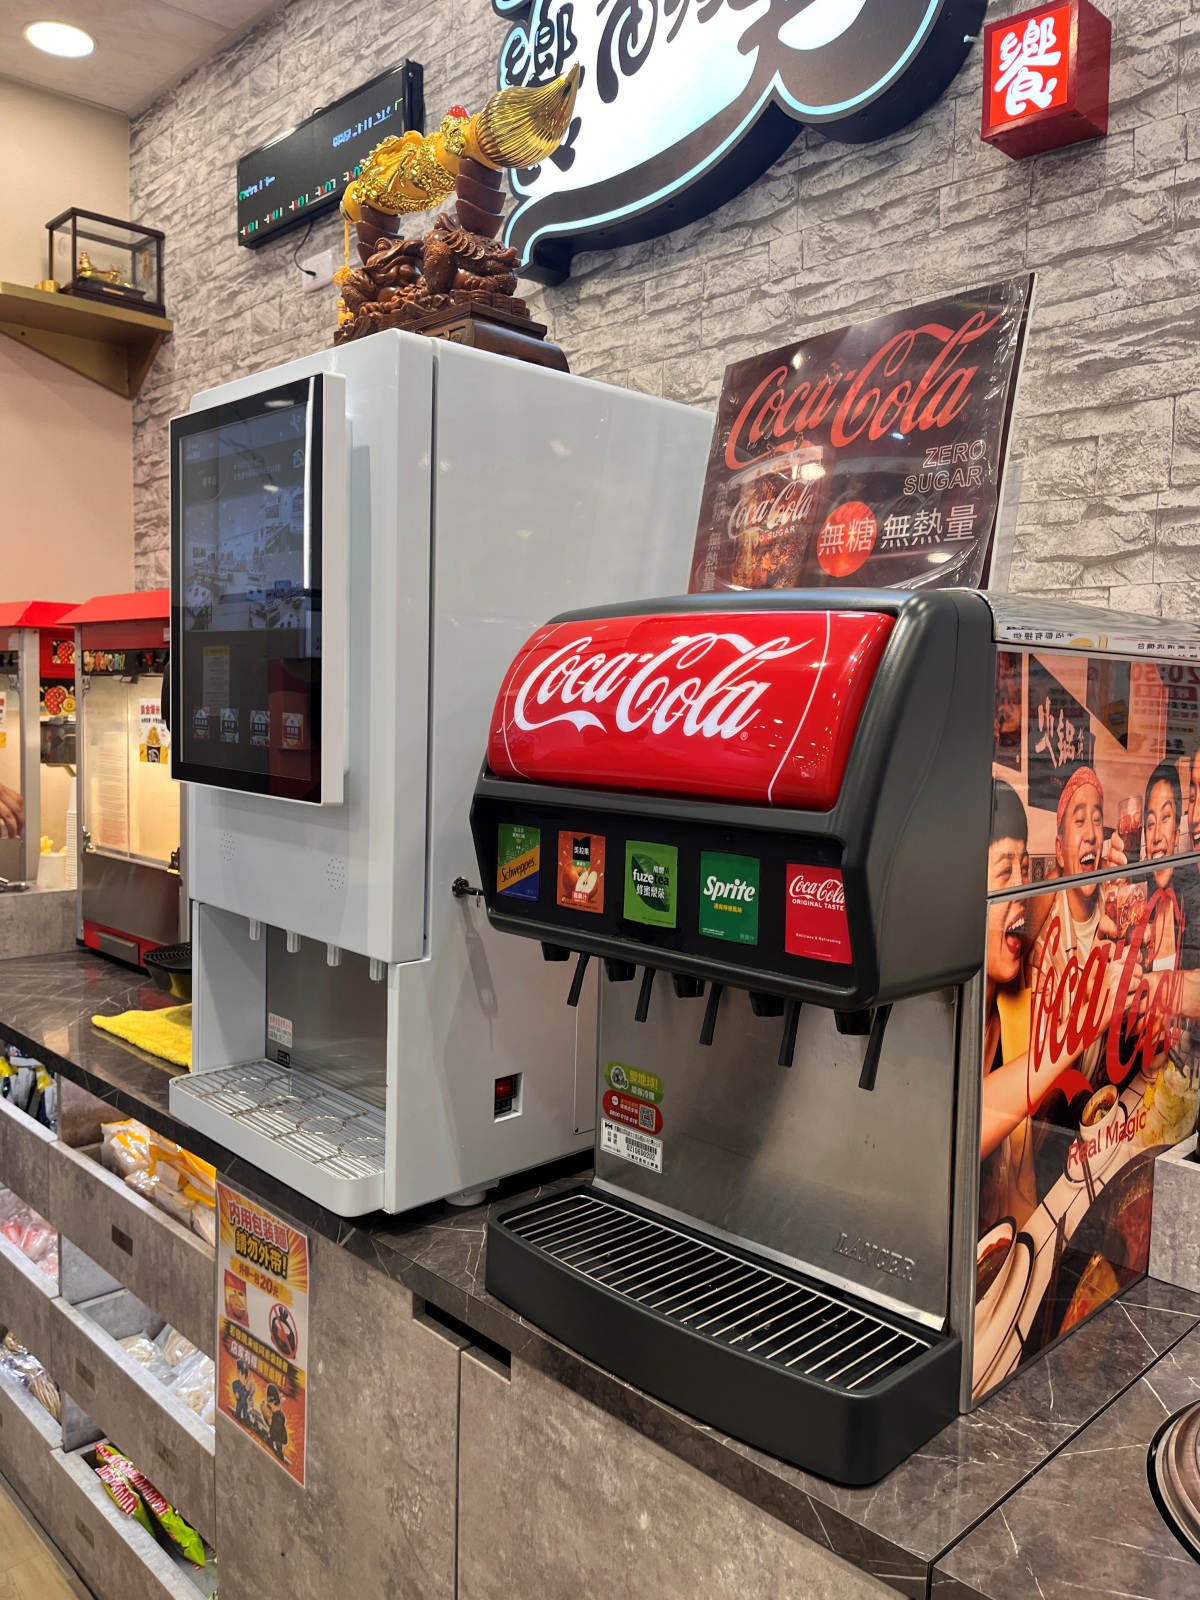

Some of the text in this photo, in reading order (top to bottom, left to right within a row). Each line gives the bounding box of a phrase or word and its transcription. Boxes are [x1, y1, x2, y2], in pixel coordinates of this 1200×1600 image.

[994, 17, 1061, 116] 饗
[725, 310, 1003, 470] Coca-Cola
[923, 439, 987, 468] ZERO
[903, 465, 982, 496] SUGAR
[818, 503, 979, 557] 無糖 無熱量
[513, 632, 816, 740] Coca-Cola
[501, 857, 535, 883] Schweppes
[703, 875, 756, 902] Sprite
[789, 875, 846, 904] Coca-Cola
[791, 898, 845, 912] ORIGINAL TASTE
[795, 932, 814, 940] Delicious
[818, 936, 842, 945] Refreshing
[1067, 1110, 1147, 1170] Real Magic
[235, 1228, 288, 1280] 請勿外帶!
[833, 1232, 915, 1282] LANCER
